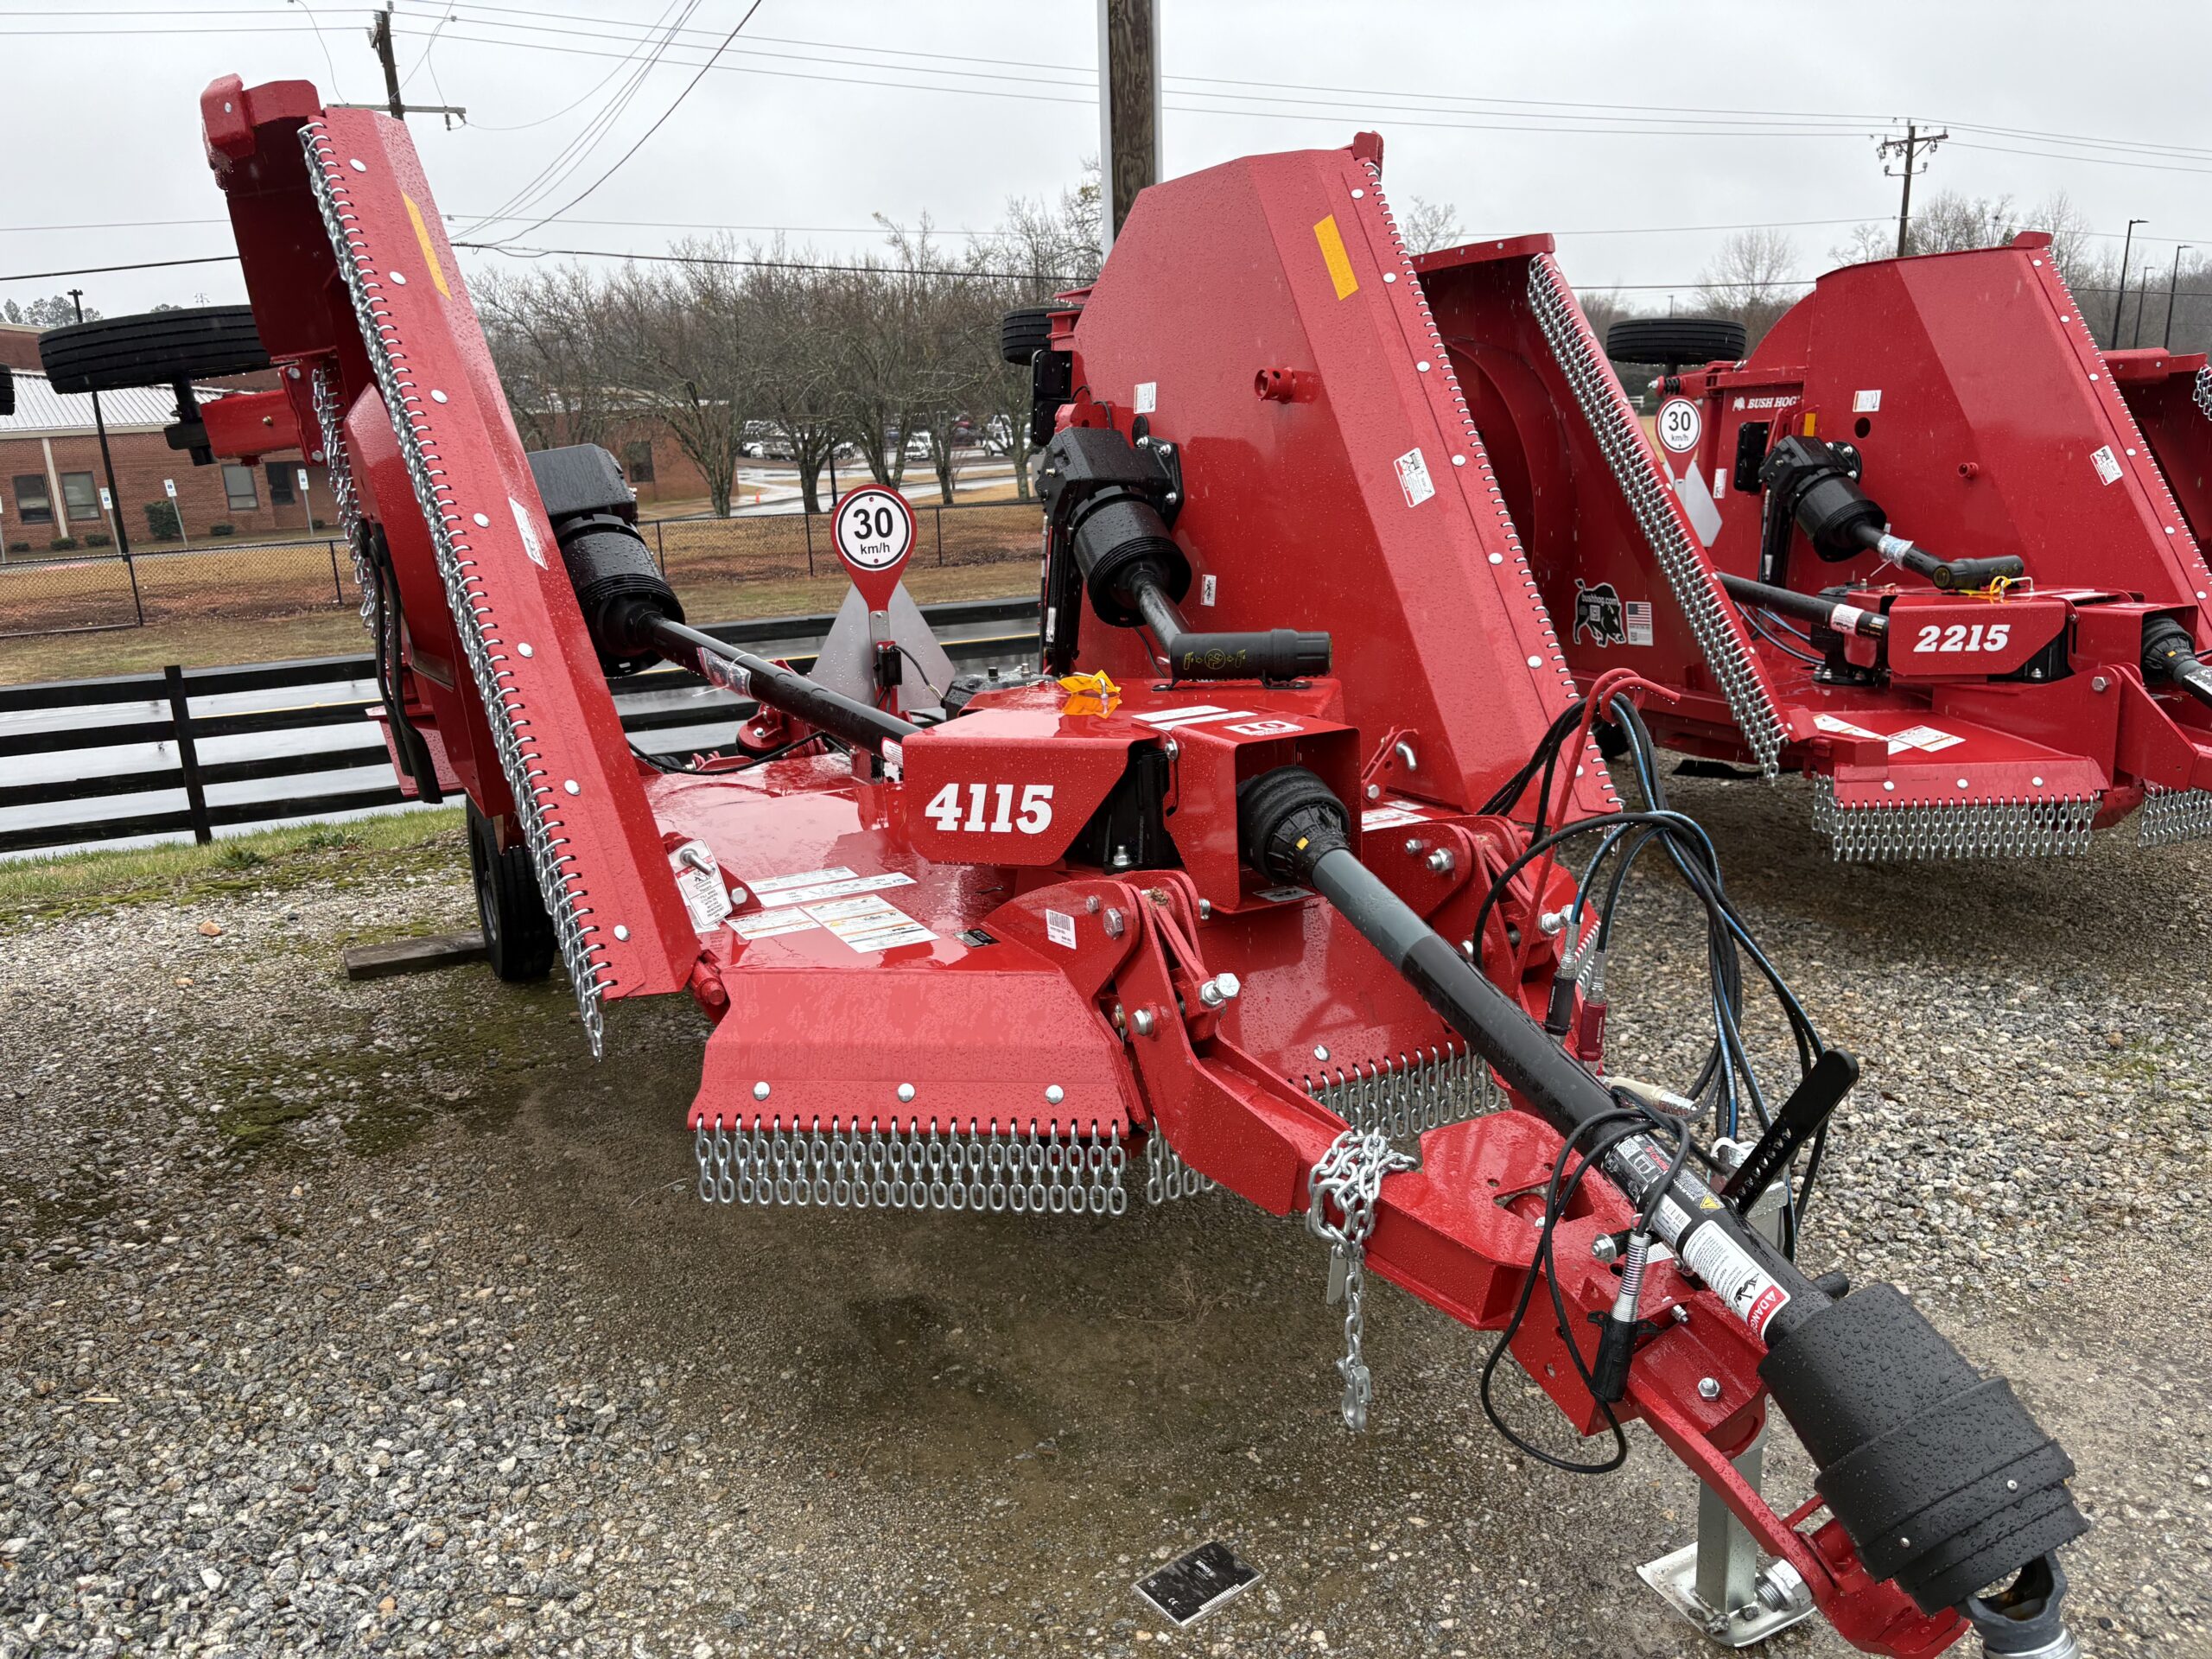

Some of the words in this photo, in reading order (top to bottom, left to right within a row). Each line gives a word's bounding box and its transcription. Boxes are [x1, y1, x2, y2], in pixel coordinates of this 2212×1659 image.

[1747, 397, 1772, 409] BUSH
[1774, 397, 1797, 407] HOG
[1669, 410, 1691, 431] 30
[853, 507, 893, 540] 30
[860, 543, 890, 555] km/h
[1581, 593, 1618, 607] bushhog.com
[1913, 624, 2011, 652] 2215
[925, 783, 1054, 834] 4115
[1673, 1178, 1695, 1201] WARNIN
